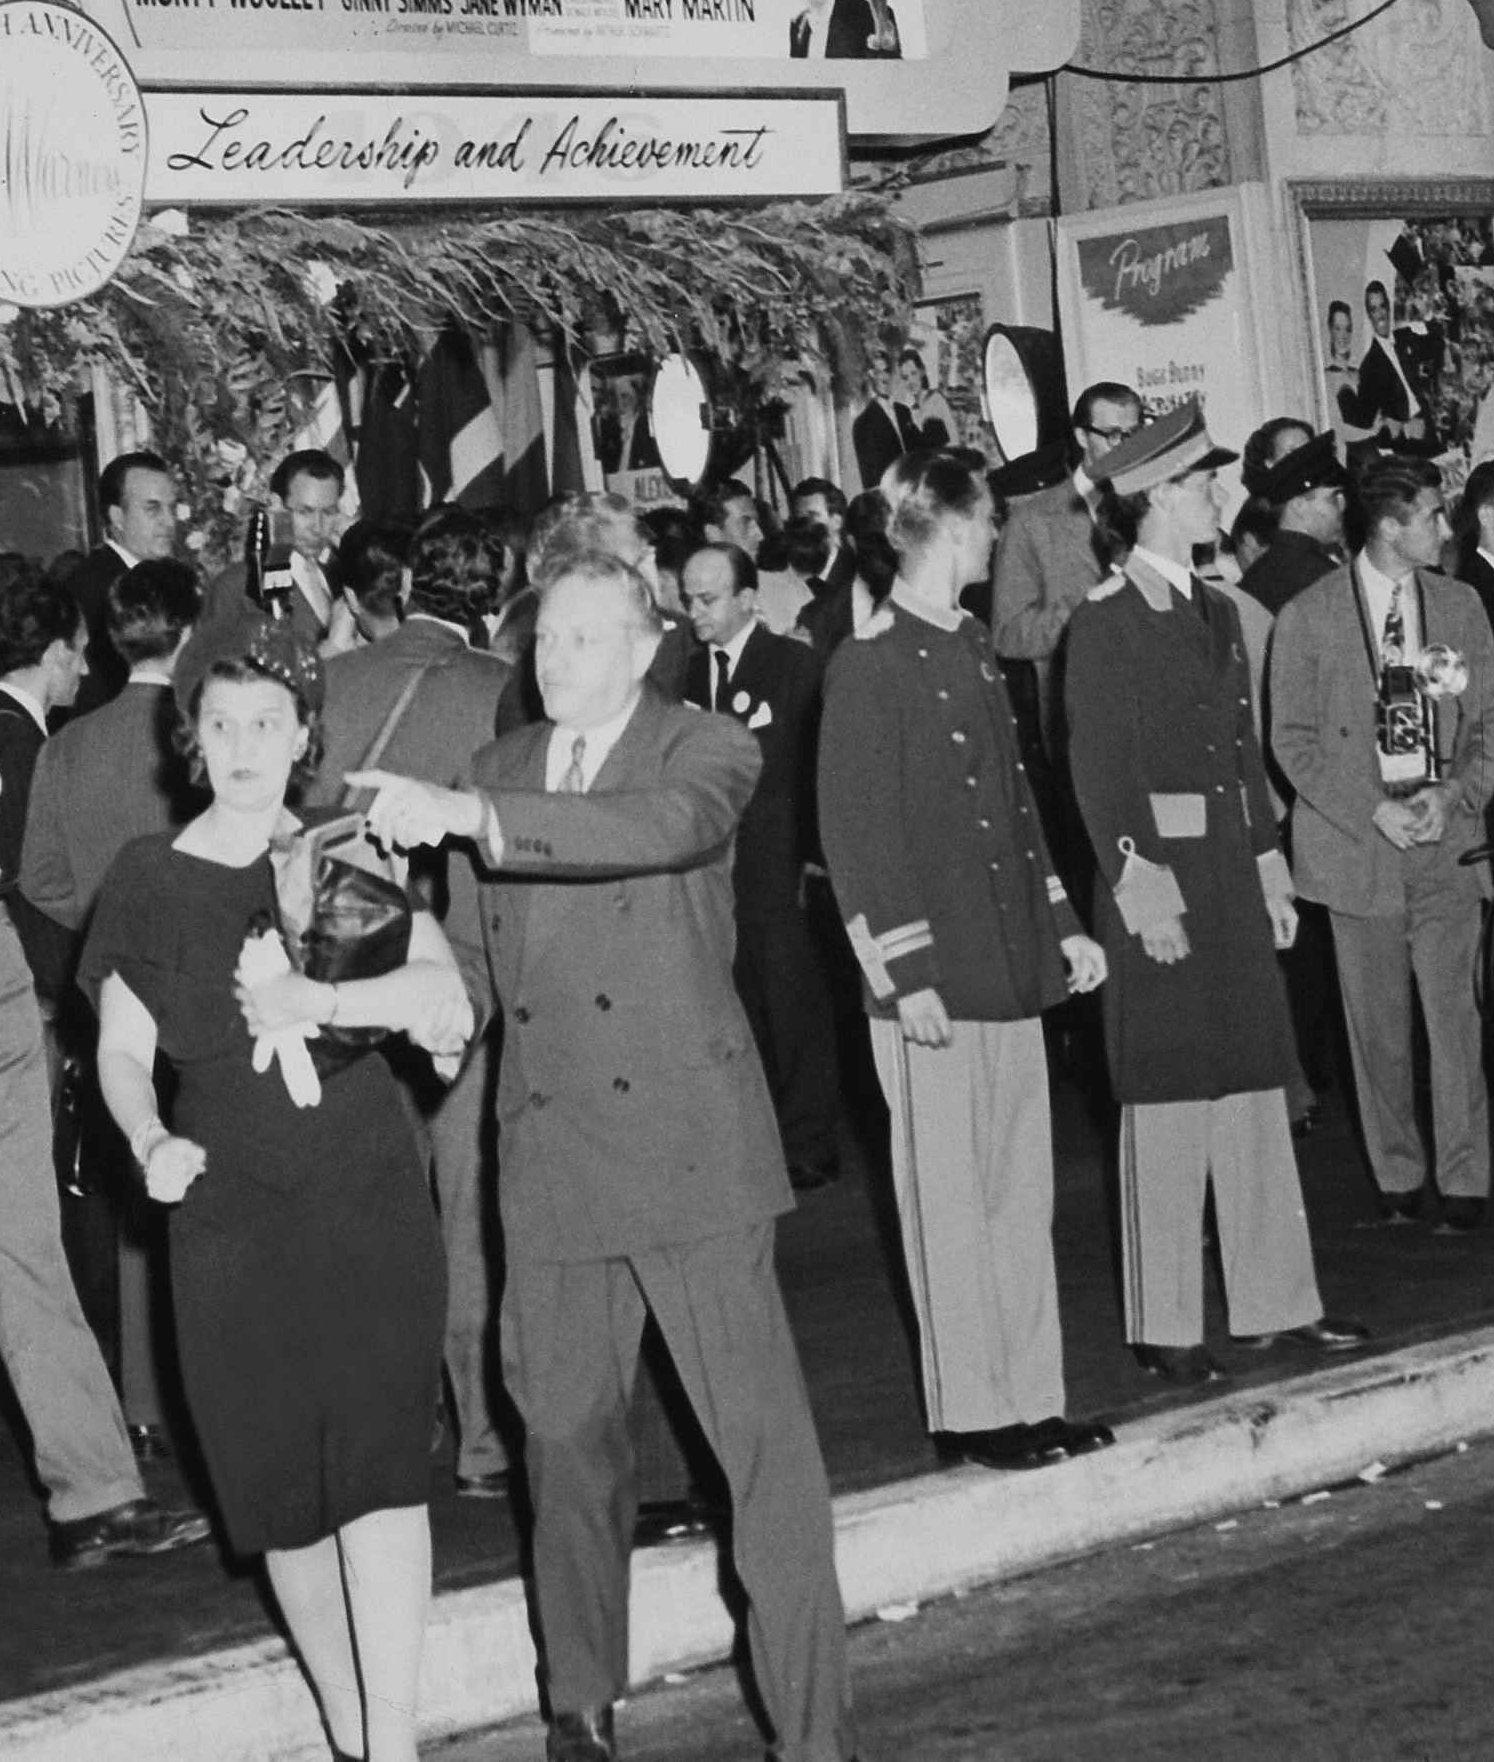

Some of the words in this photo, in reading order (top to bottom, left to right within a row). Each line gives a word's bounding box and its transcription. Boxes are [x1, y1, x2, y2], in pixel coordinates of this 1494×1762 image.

[20, 11, 141, 156] ANNIVERSARY
[166, 107, 439, 190] Leadership
[453, 117, 532, 173] and
[539, 114, 779, 176] Achievement
